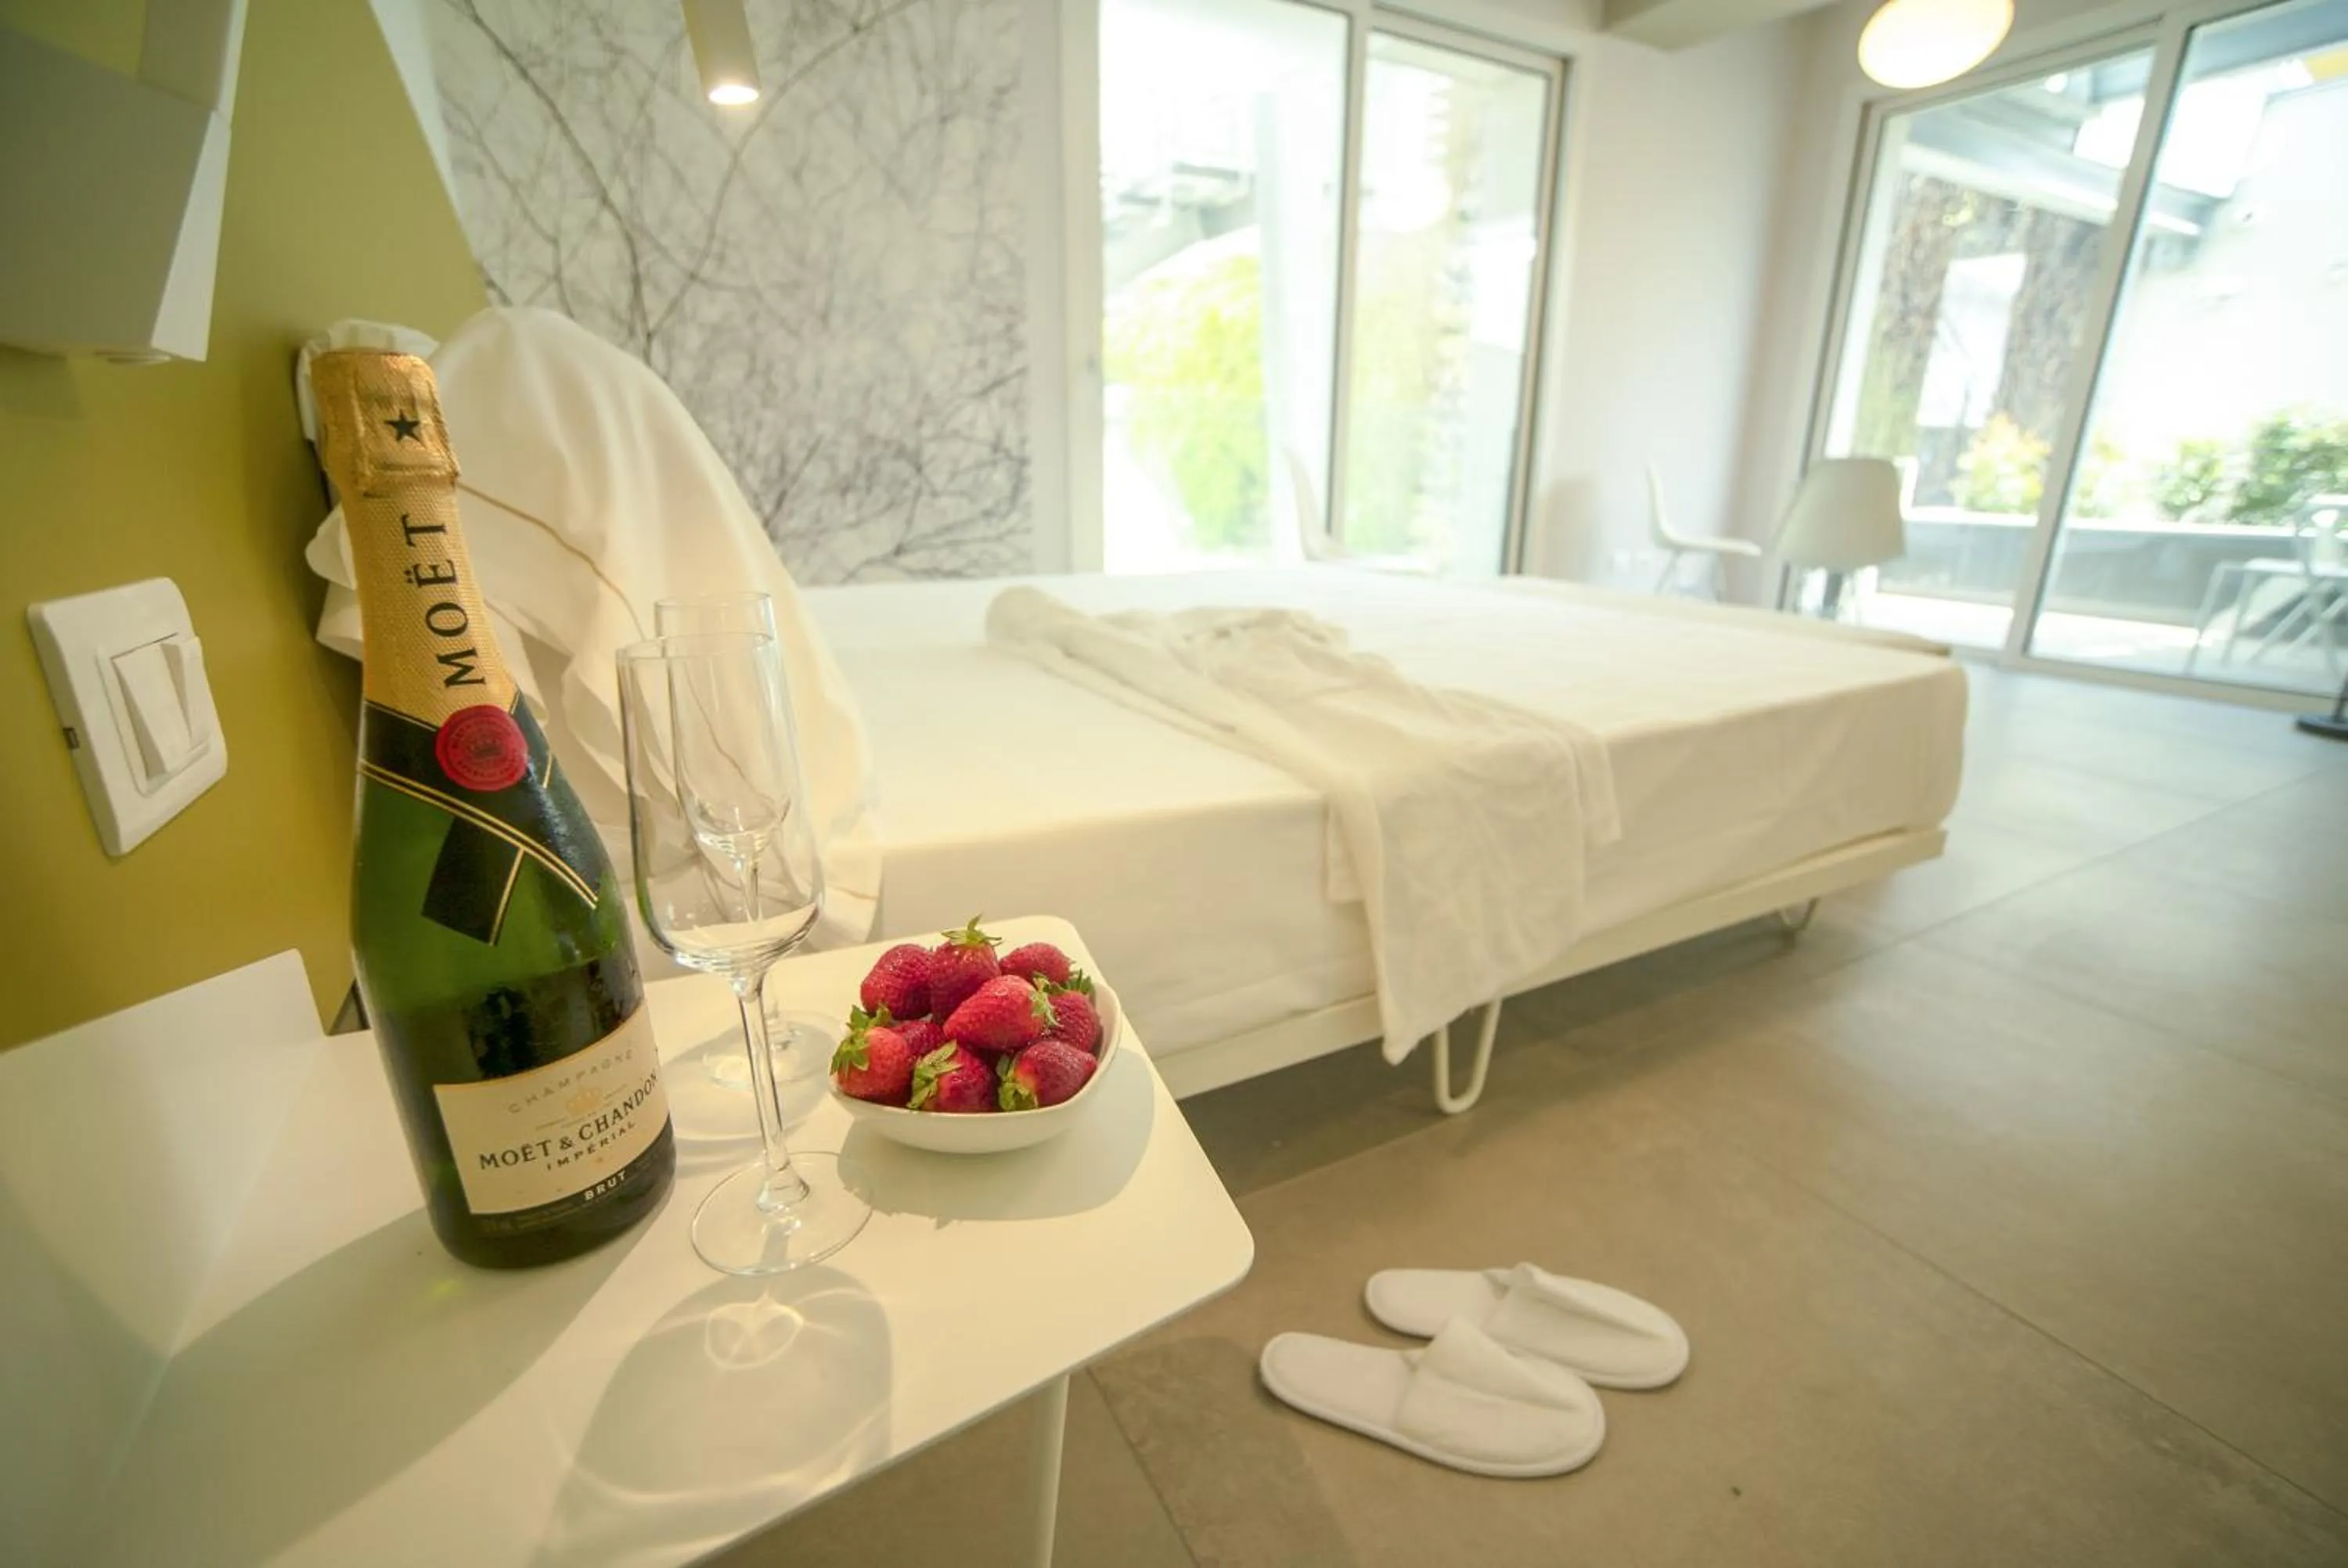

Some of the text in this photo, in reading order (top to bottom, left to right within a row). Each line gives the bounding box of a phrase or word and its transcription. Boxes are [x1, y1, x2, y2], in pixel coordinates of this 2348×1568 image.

[401, 513, 487, 687] MOËT
[508, 1049, 633, 1114] CHAMPAGNE
[560, 1136, 573, 1150] &
[578, 1070, 658, 1141] CHANDON
[584, 1171, 626, 1201] BRUT
